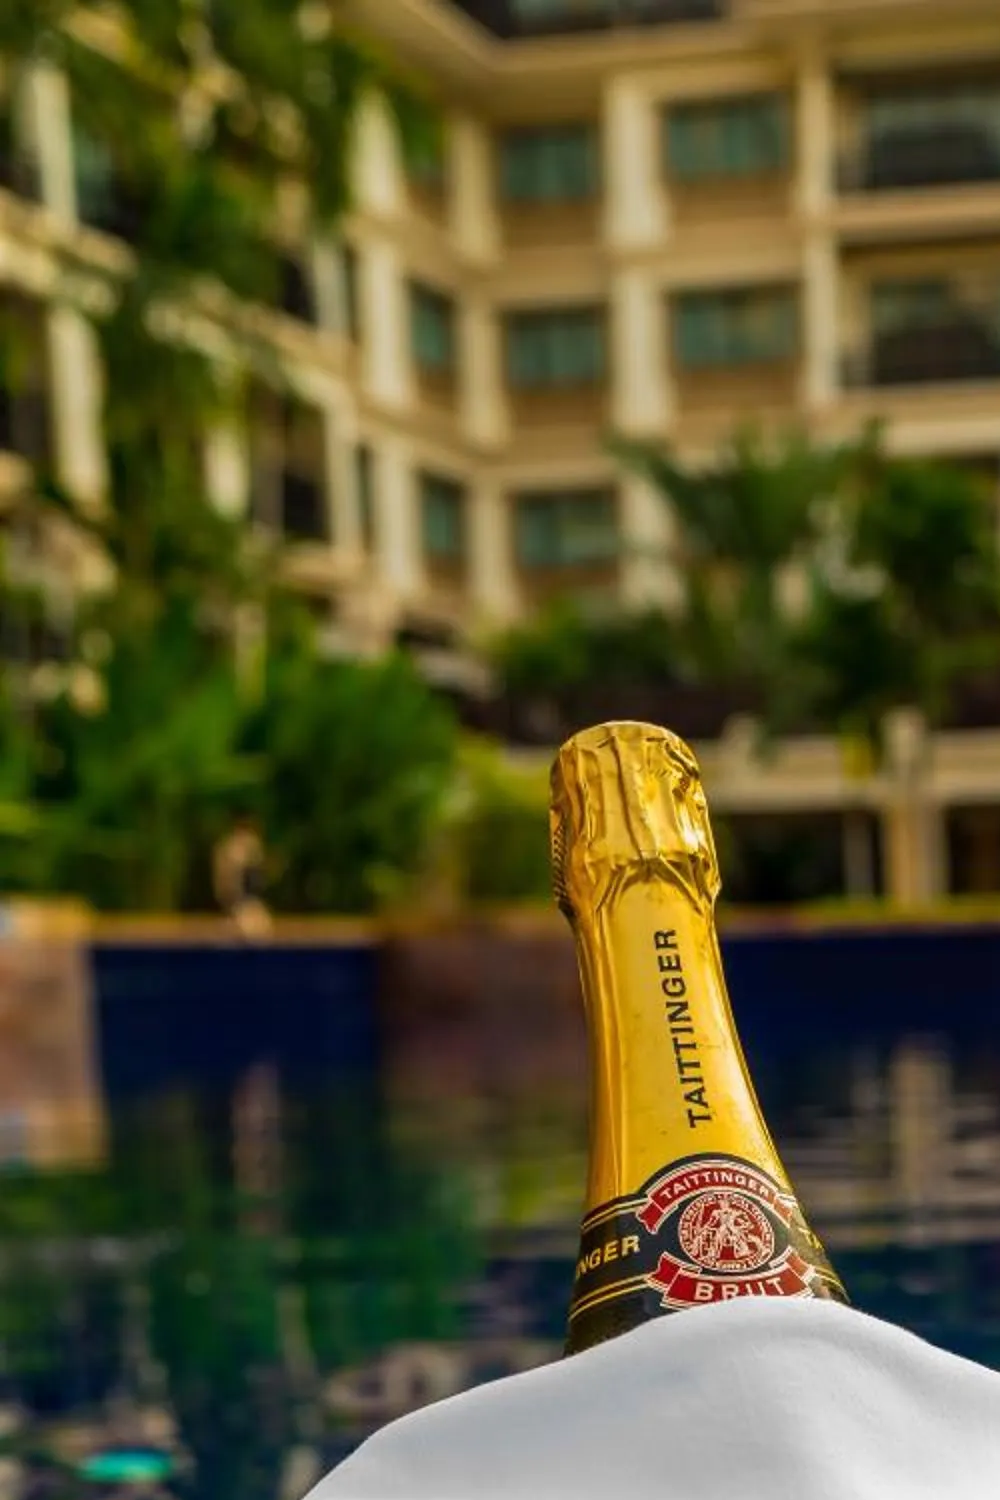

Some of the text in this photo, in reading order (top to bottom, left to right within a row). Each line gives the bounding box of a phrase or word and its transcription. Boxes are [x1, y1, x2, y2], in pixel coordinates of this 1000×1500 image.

[654, 929, 712, 1128] TAITTINGER
[660, 1171, 770, 1200] TAITTINGER
[694, 1277, 785, 1302] BRUT
